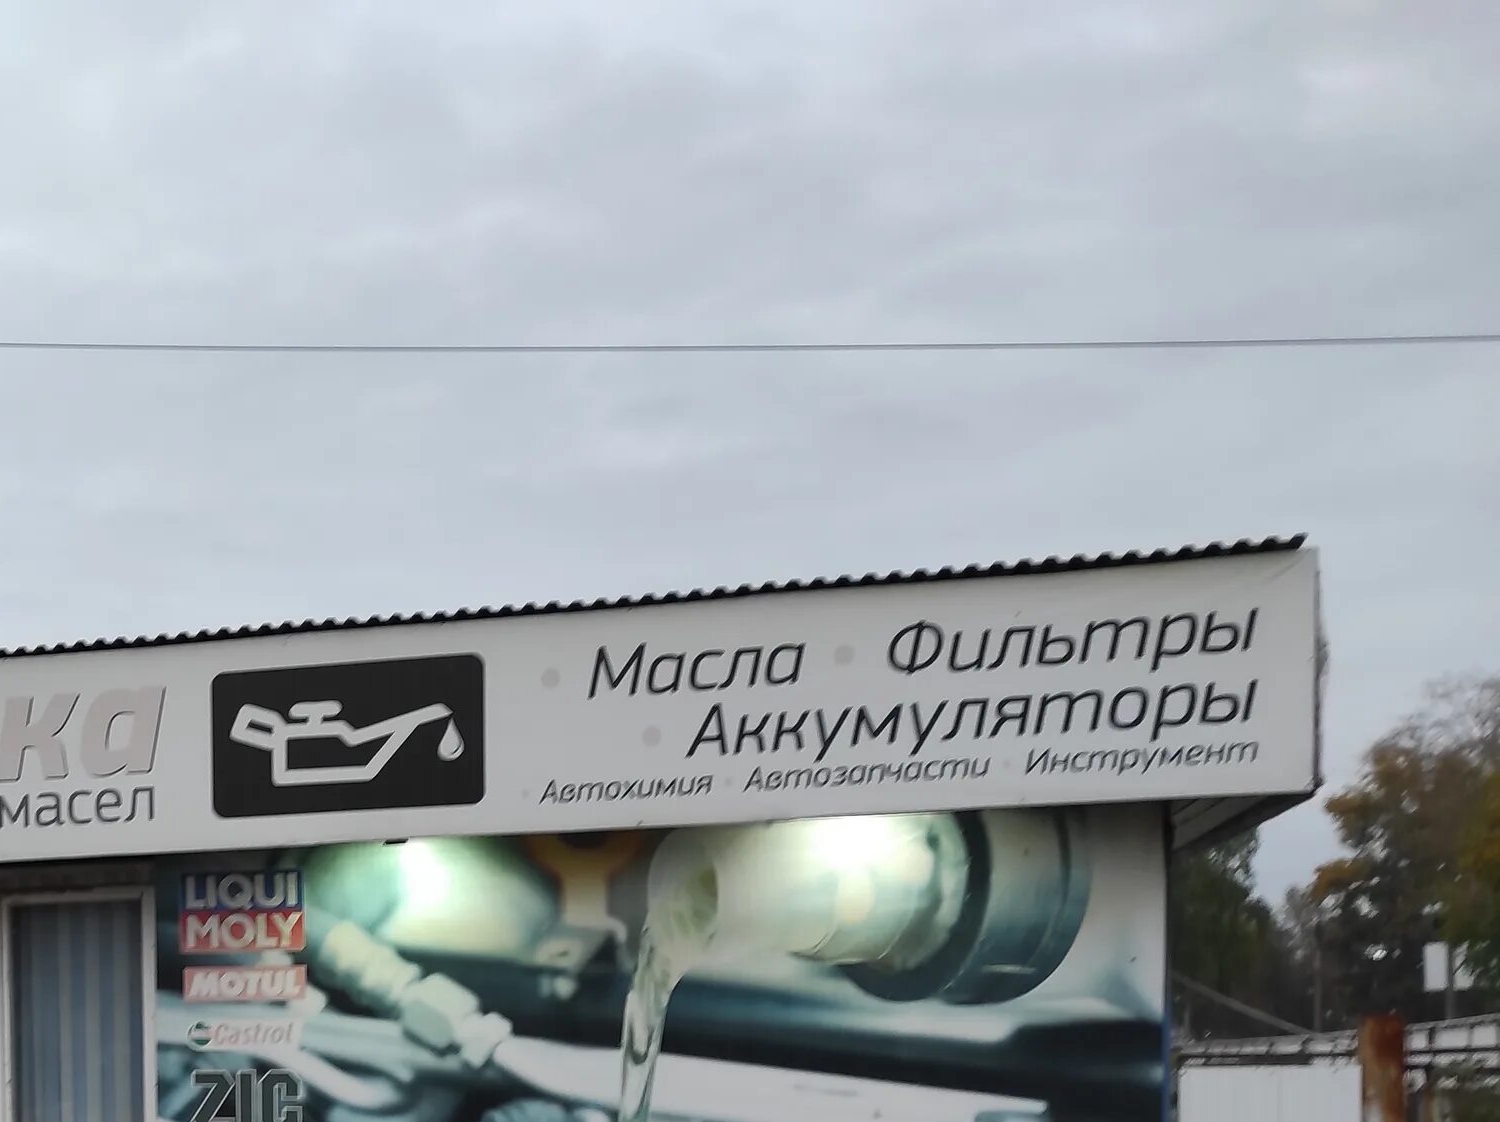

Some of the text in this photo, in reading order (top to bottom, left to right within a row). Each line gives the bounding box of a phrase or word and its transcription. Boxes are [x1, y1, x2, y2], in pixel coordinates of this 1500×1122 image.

[587, 607, 1260, 700] Масла Фильтры
[686, 678, 1259, 759] Аккумуляторы
[540, 739, 1260, 804] Автохимия Автозапчасти Инструмент
[185, 873, 299, 910] LIQUI
[186, 911, 303, 949] MOLY
[188, 969, 301, 998] MOTUL
[214, 1022, 293, 1046] Castrol
